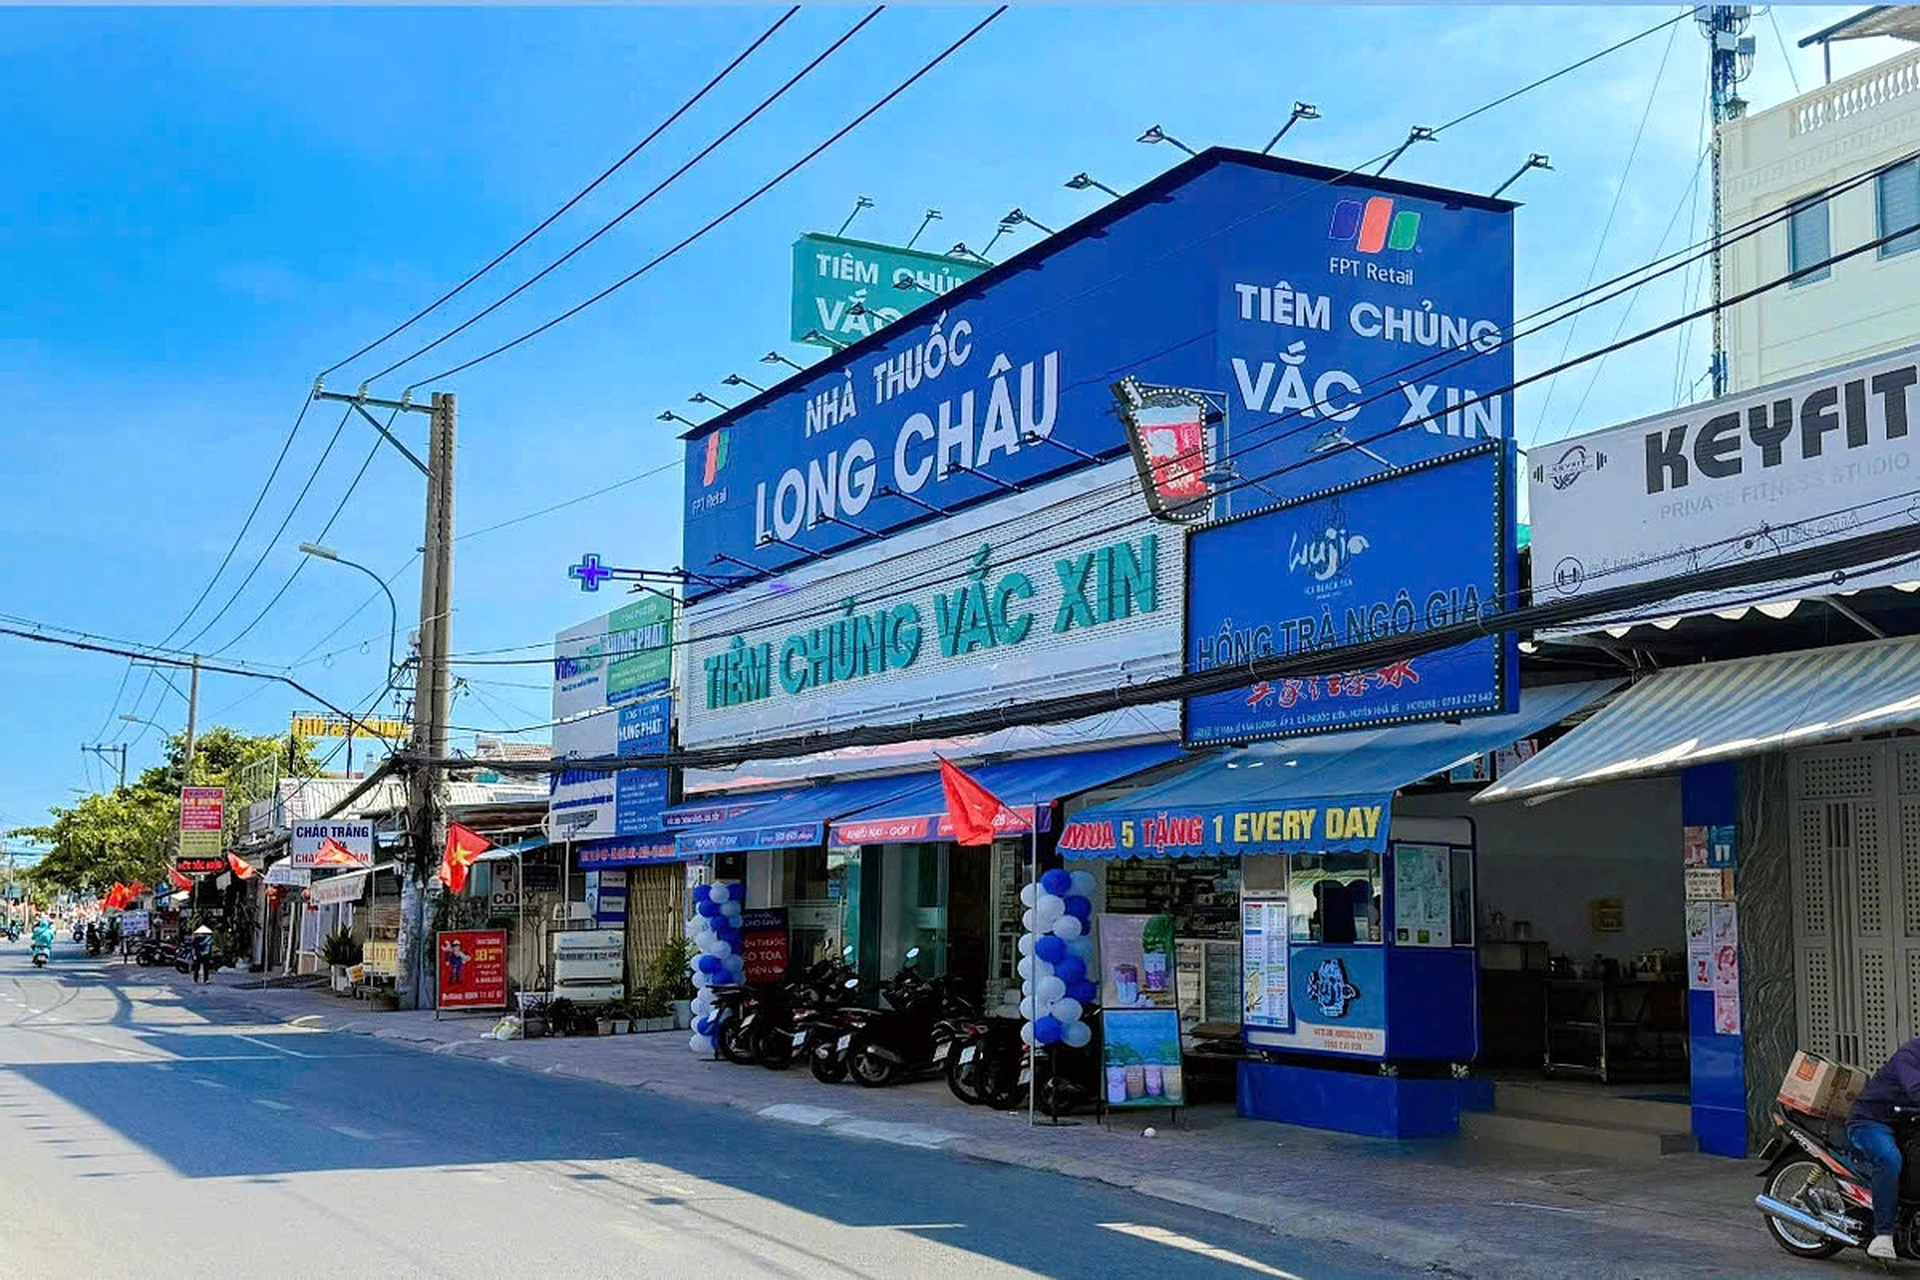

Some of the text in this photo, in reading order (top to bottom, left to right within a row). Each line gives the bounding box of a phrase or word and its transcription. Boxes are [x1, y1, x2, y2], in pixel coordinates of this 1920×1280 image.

[815, 252, 879, 286] TIÊM
[1329, 256, 1414, 287] FPT Retail
[1235, 280, 1502, 356] TIÊM CHỦNG
[806, 310, 973, 439] NHÀ THUỐC
[1231, 340, 1502, 439] VẮC XIN
[755, 437, 876, 550] LONG
[894, 350, 1060, 494] CHÂU
[1645, 365, 1917, 494] KEYFIT
[704, 534, 1158, 710] TIÊM CHỦNG VẮC XIN
[1195, 584, 1480, 673] HỒNG TRÀ NGÔ GIA
[1058, 819, 1115, 850] MUA
[1121, 820, 1135, 848] 5
[1141, 811, 1204, 854] TẶNG
[1212, 815, 1223, 844] 1
[1234, 808, 1316, 844] EVERY
[1325, 804, 1382, 841] DAY
